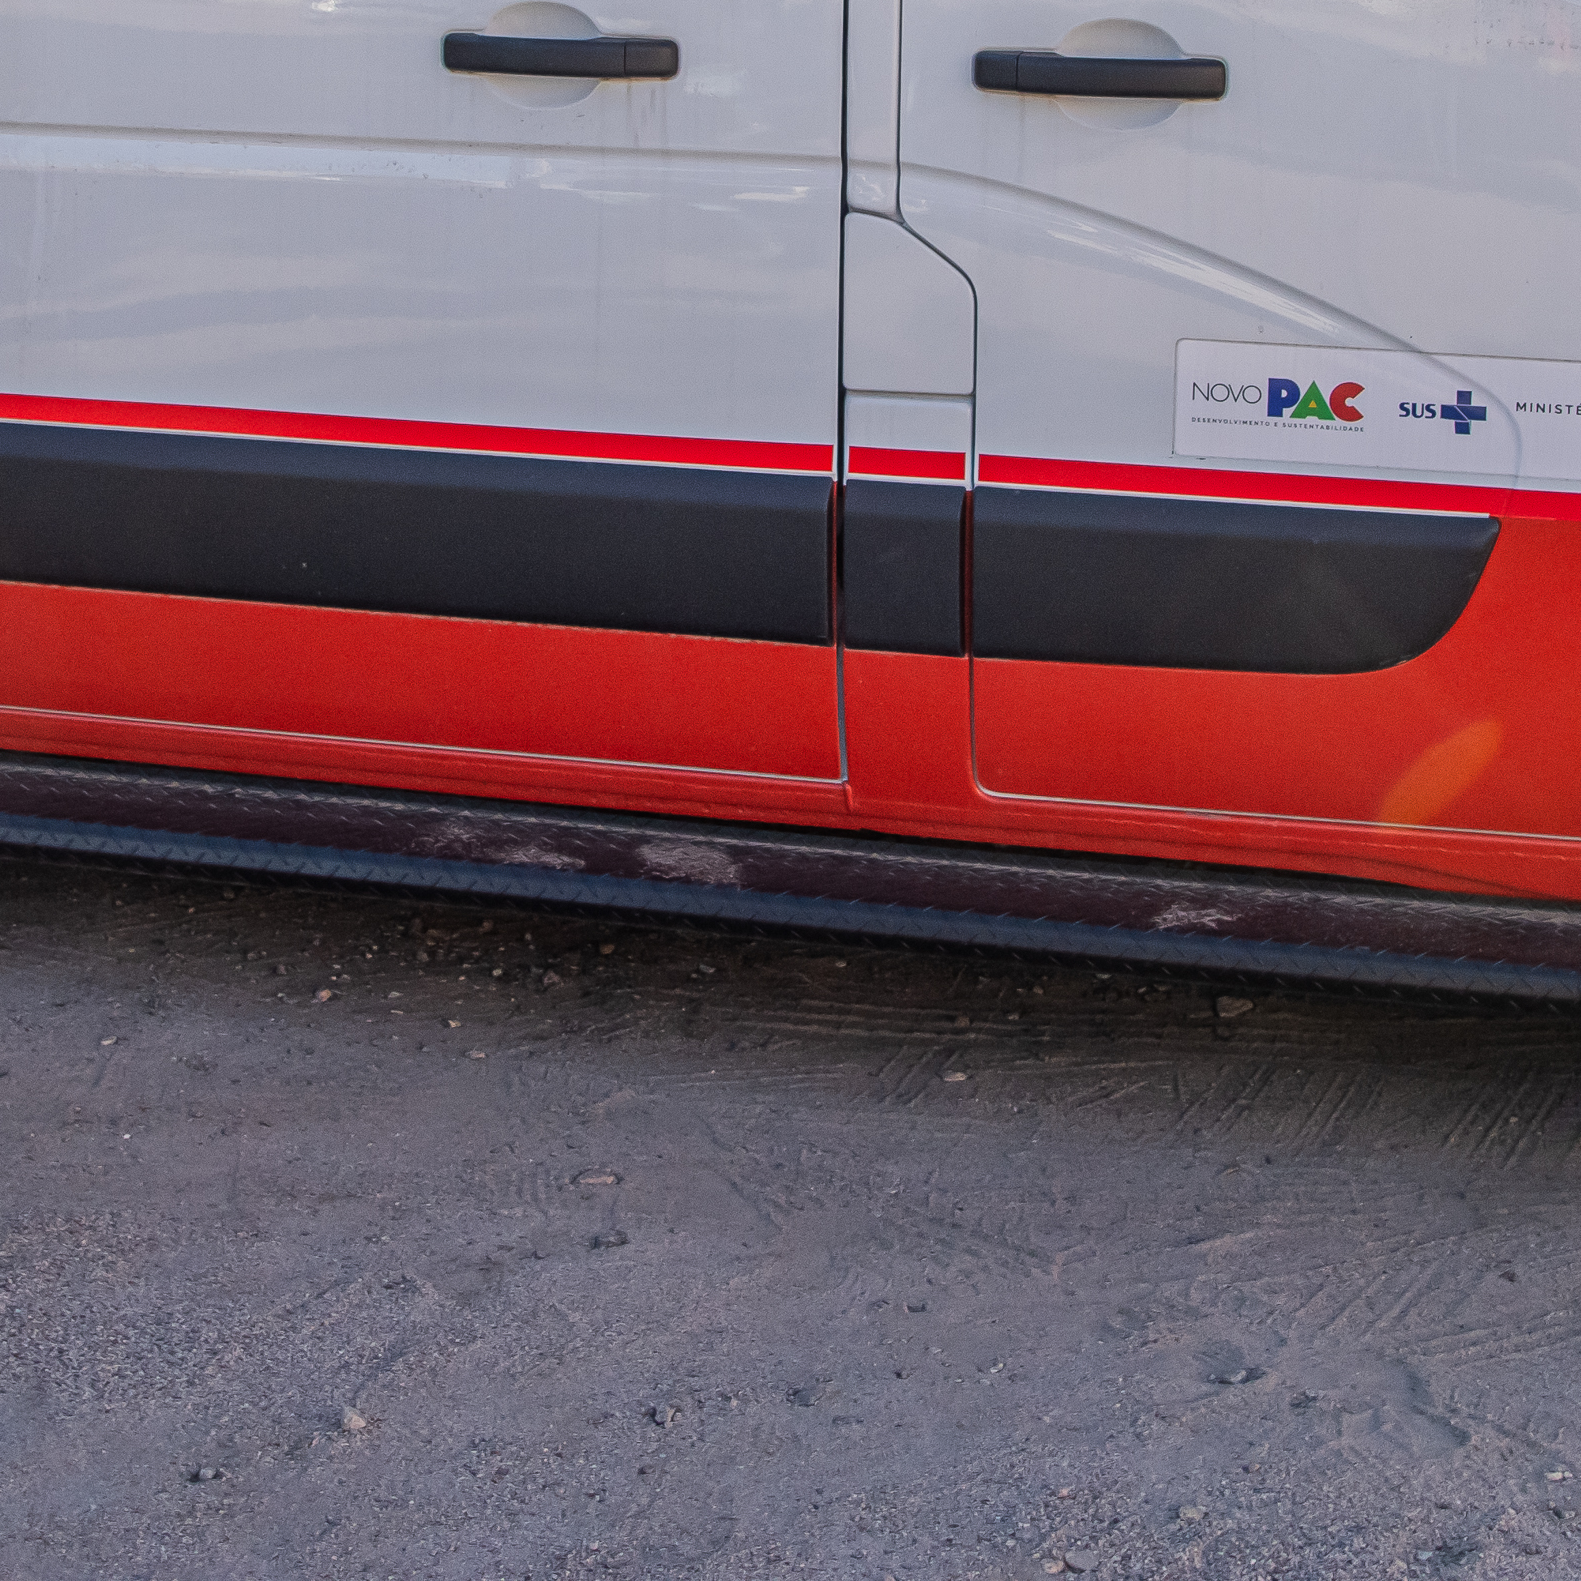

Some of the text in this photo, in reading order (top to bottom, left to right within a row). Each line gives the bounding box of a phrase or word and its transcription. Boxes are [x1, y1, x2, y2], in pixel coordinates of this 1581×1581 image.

[1192, 377, 1365, 423] NOVO PAC
[1398, 402, 1437, 419] SUS
[1191, 417, 1270, 427] DESENVOLVIMENTO
[1282, 422, 1364, 432] SUSTENTABILIDADE
